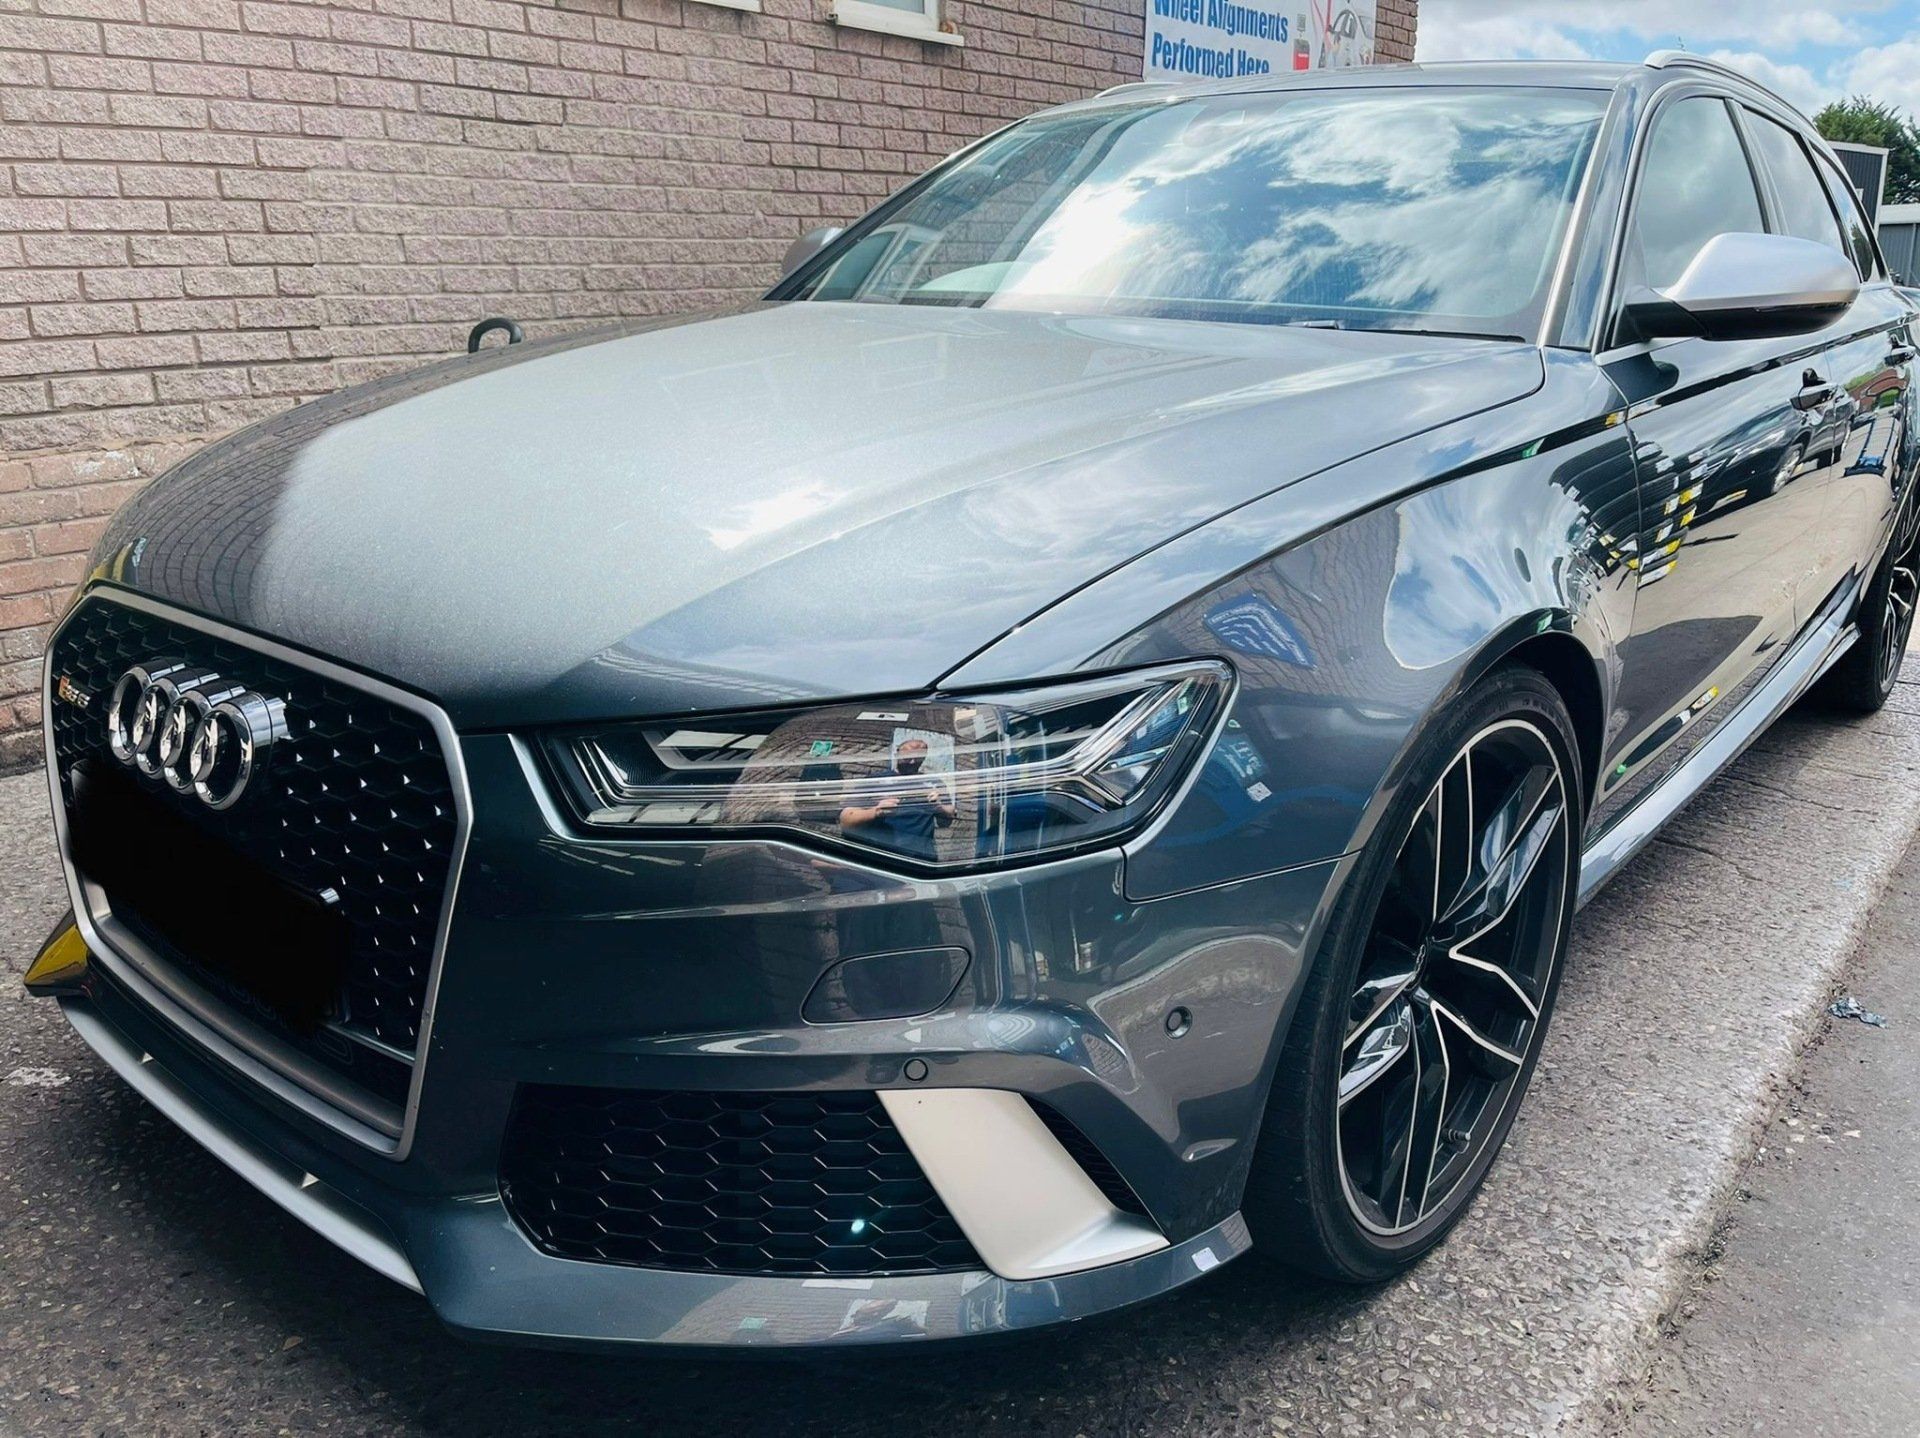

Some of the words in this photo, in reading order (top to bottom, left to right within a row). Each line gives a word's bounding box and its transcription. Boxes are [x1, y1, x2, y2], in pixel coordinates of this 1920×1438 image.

[1207, 0, 1287, 43] Alignments
[1152, 32, 1234, 78] Performed
[1237, 49, 1270, 75] Here
